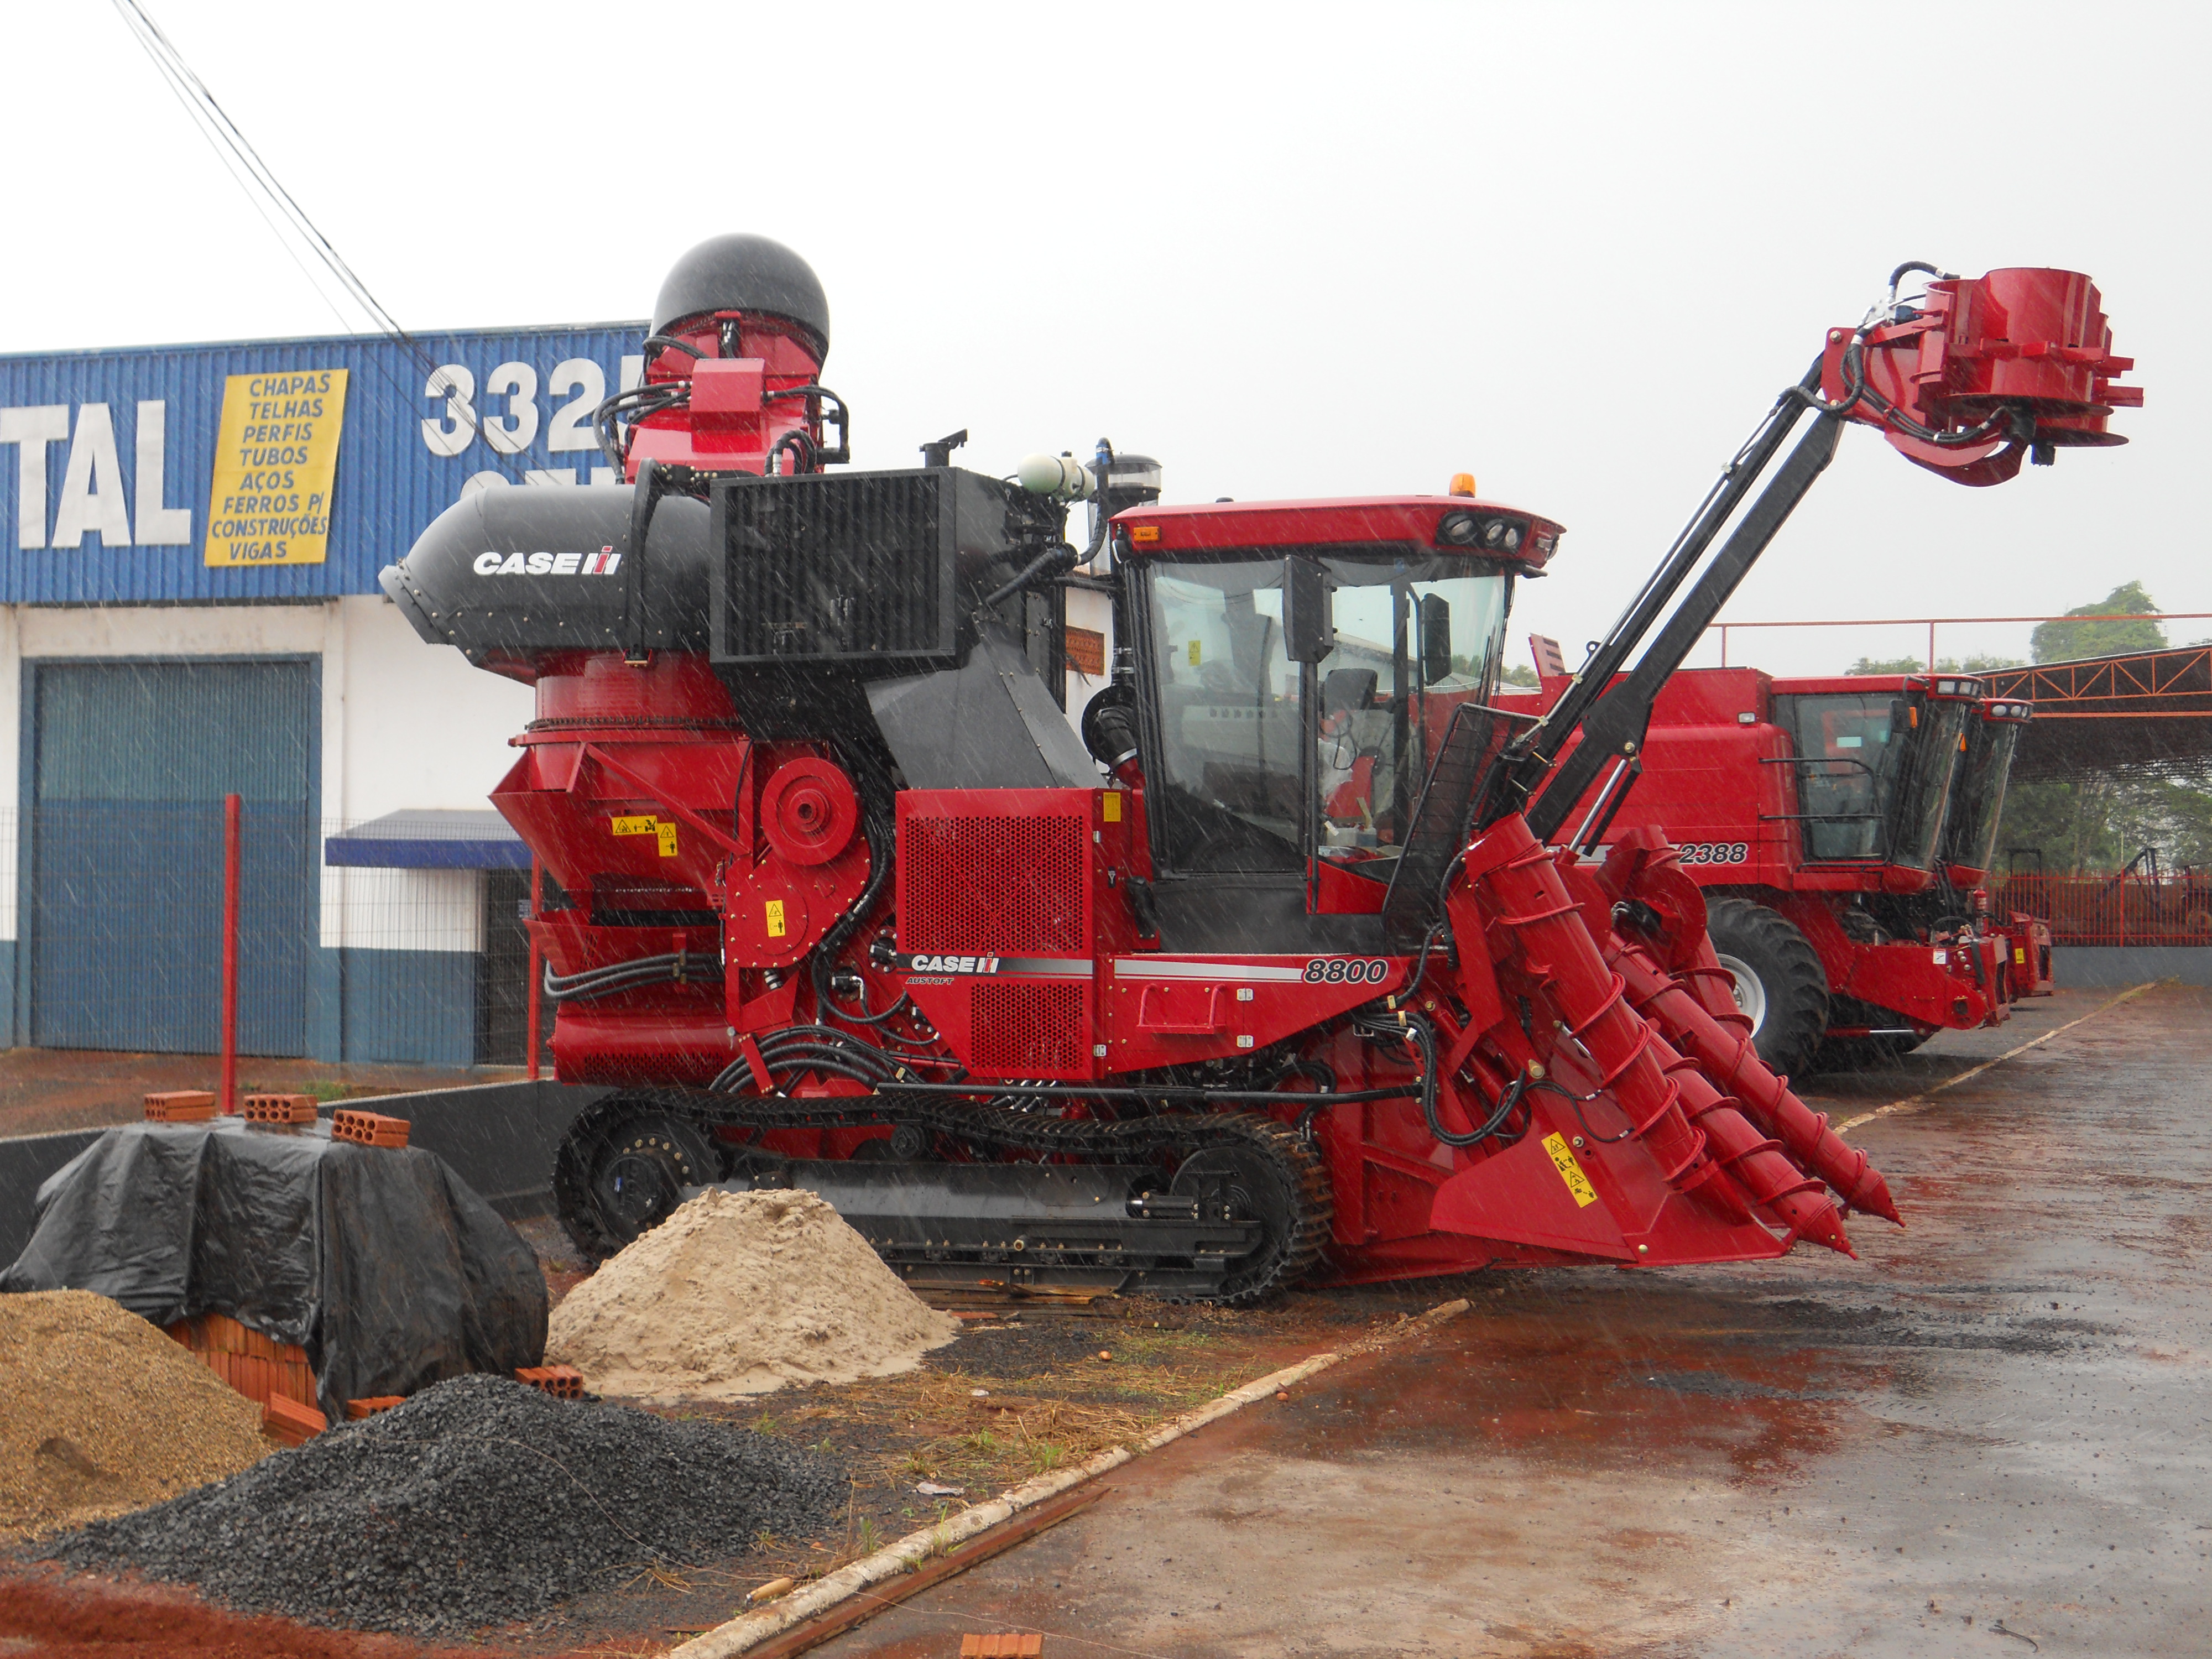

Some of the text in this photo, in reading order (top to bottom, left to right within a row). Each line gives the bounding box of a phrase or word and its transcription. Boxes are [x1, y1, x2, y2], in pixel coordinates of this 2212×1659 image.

[249, 373, 331, 397] CHAPAS
[249, 398, 324, 420] TELHAS
[242, 422, 313, 443] PERFIS
[239, 446, 308, 467] TUBOS
[239, 470, 295, 493] AÇOS
[223, 491, 325, 515] FERROS P/
[211, 513, 327, 539] CONSTRUÇÕES
[229, 540, 287, 560] VIGAS
[473, 551, 582, 576] CASE
[1678, 842, 1749, 865] 2388
[911, 954, 976, 973] CASE
[1303, 958, 1389, 984] 8800
[905, 977, 954, 985] AUSTOFT
